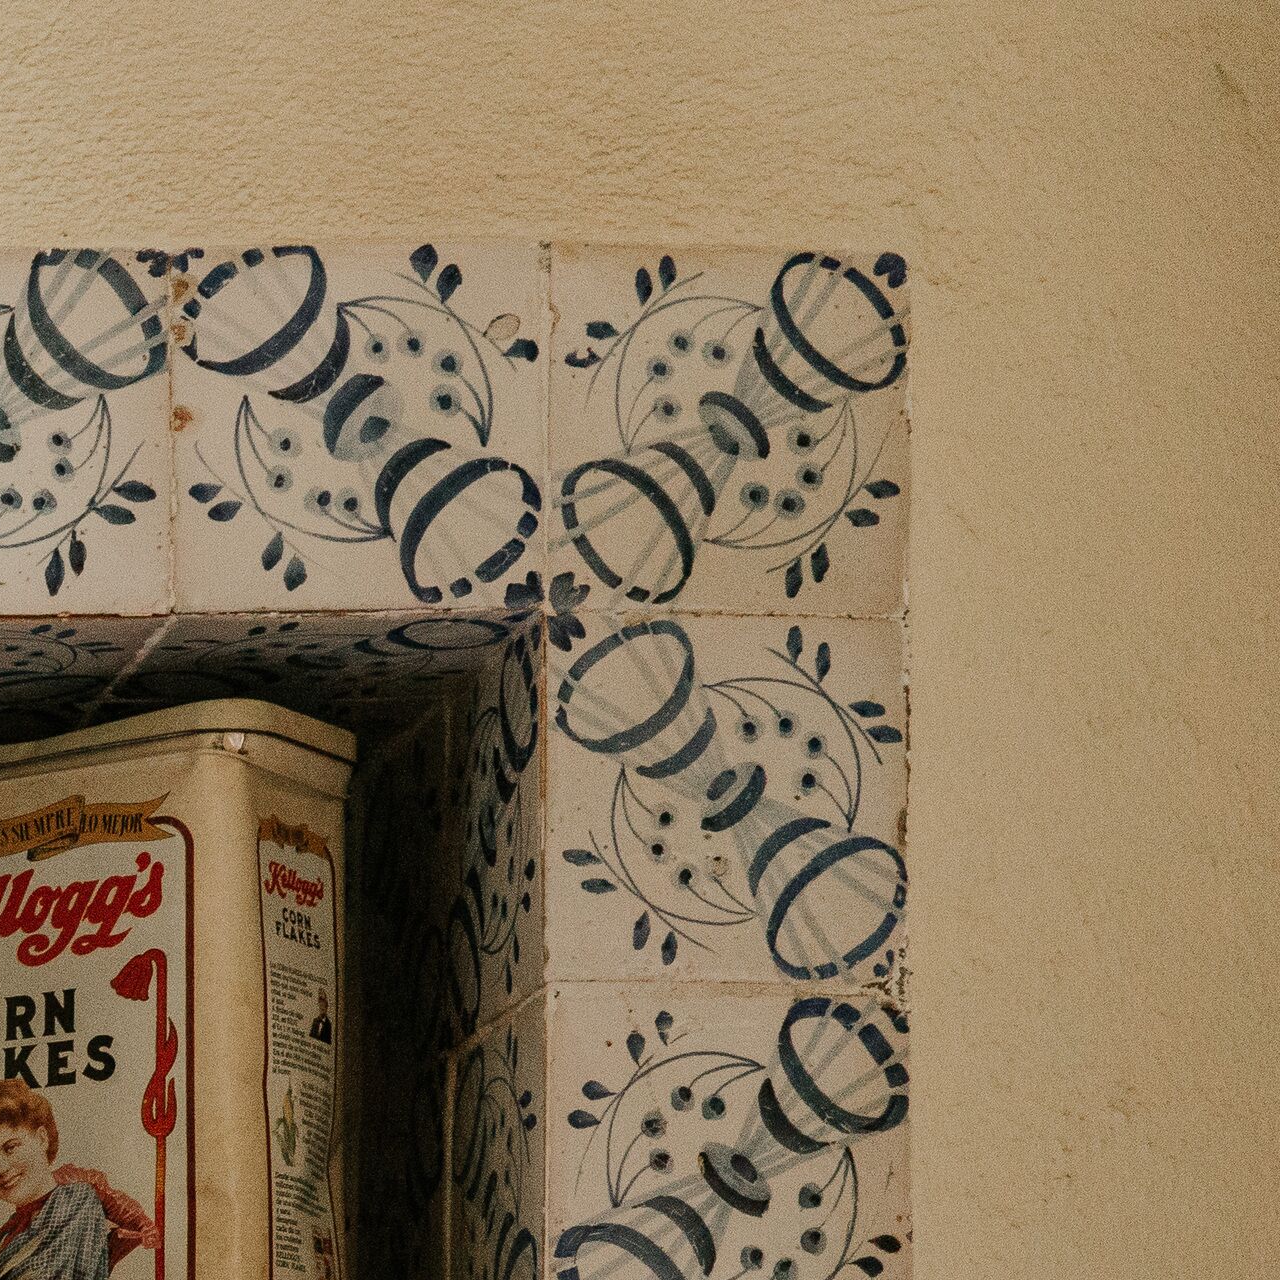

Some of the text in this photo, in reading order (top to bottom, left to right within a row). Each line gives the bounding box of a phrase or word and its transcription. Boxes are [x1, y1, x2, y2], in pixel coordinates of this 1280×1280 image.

[11, 808, 74, 842] SIEMPRE
[102, 813, 144, 837] MEJOR
[264, 860, 324, 908] Kellogg's
[275, 920, 320, 950] FLAKES
[282, 907, 312, 931] CORN
